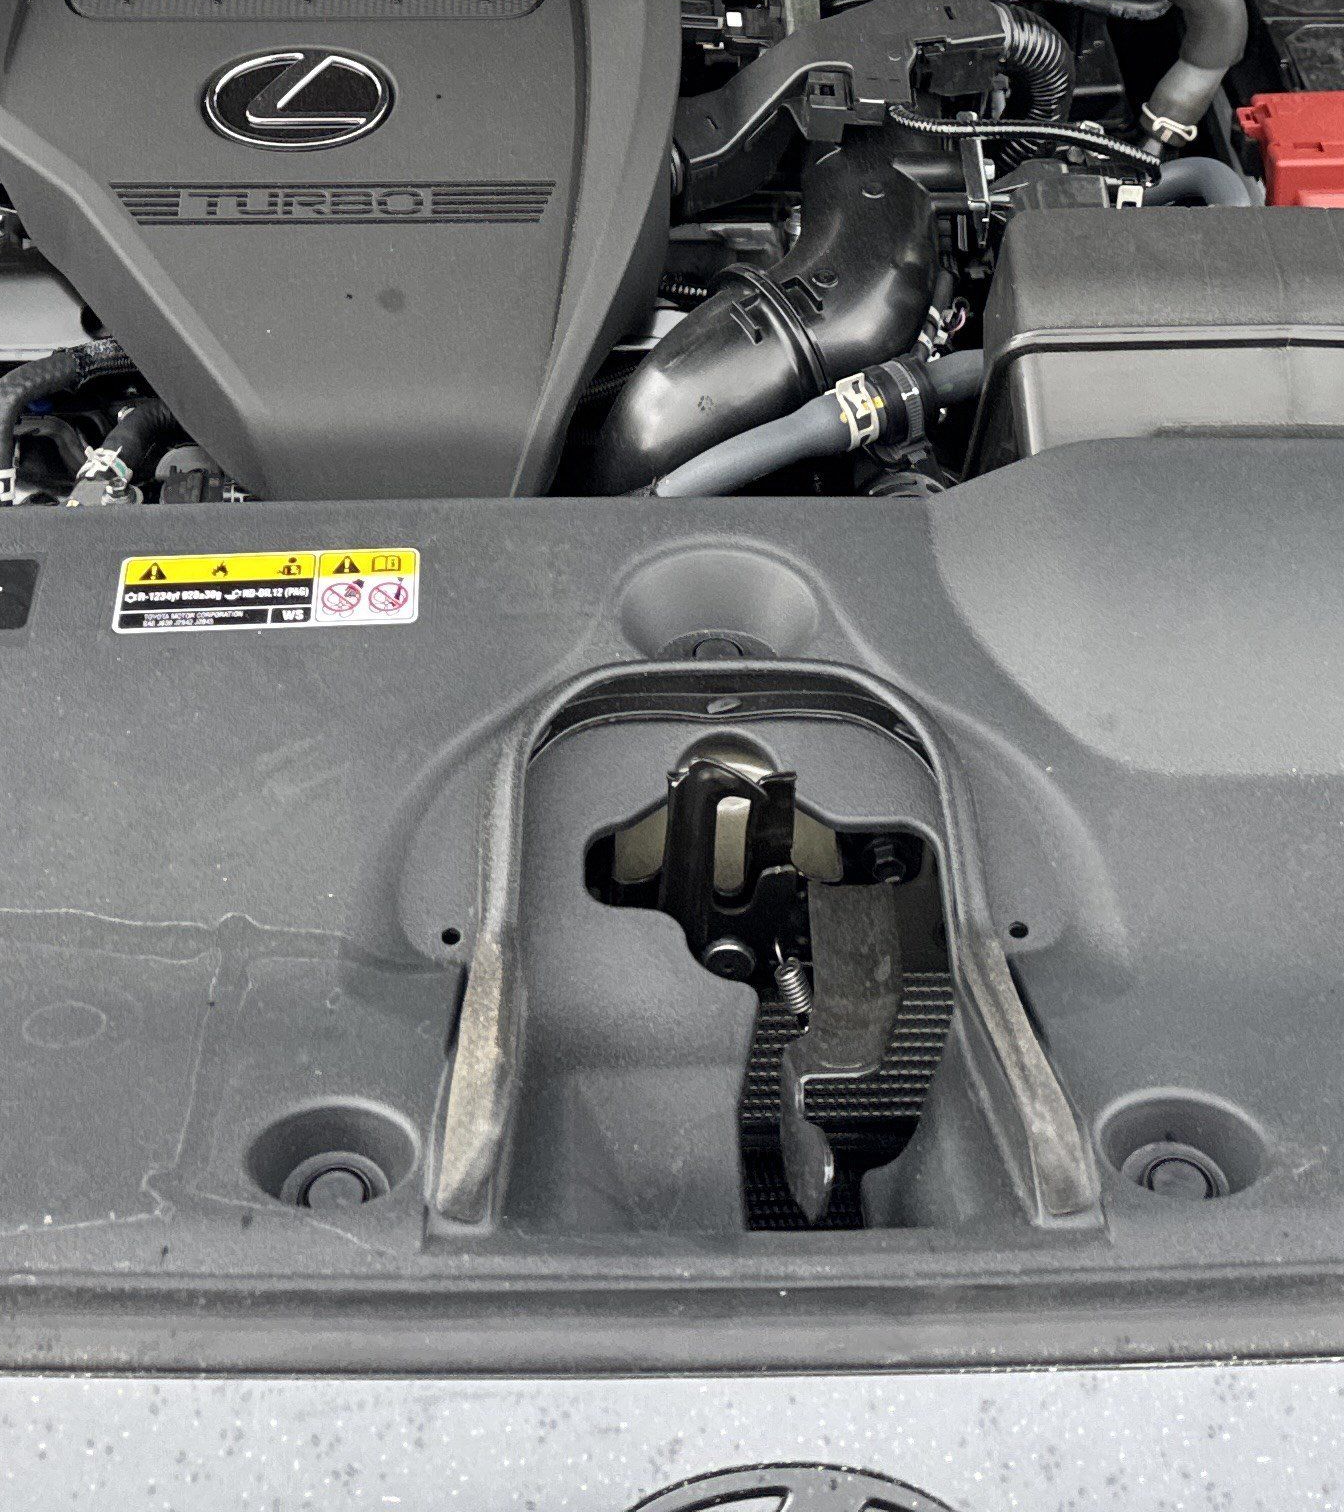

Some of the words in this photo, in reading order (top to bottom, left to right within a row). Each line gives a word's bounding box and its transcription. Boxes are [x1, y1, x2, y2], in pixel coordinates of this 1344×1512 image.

[188, 187, 425, 216] TURBO
[143, 613, 170, 621] TOYOTA
[196, 610, 244, 619] CORPORATION
